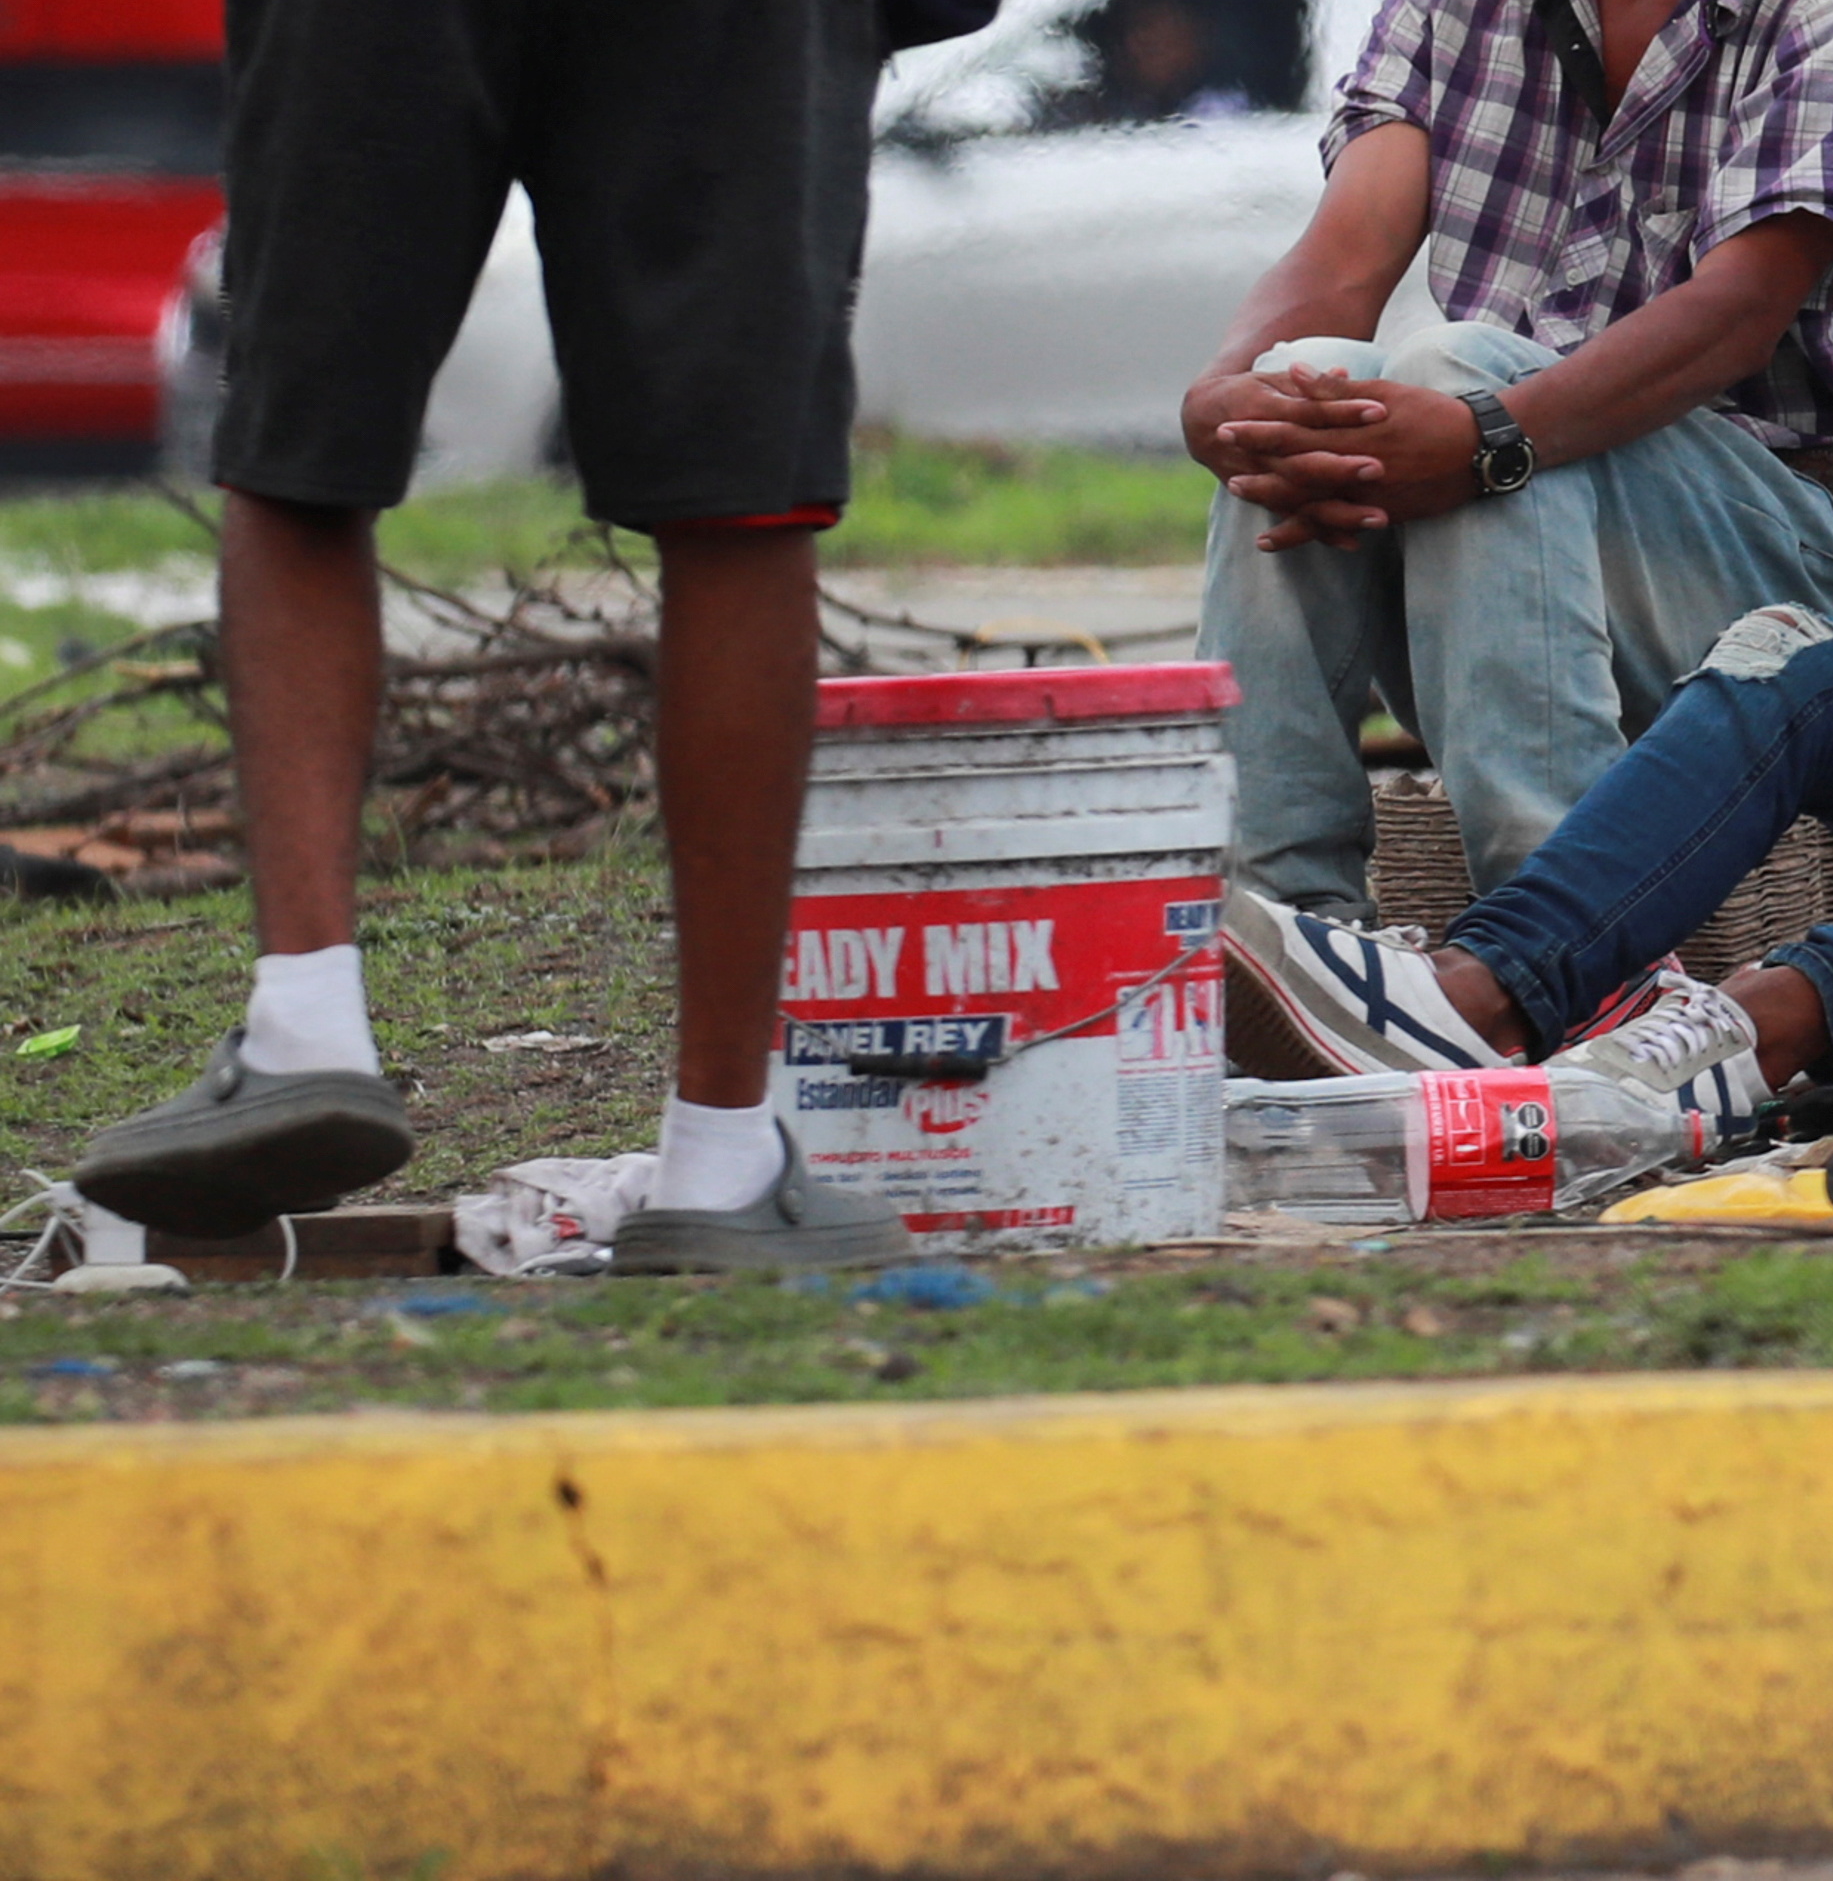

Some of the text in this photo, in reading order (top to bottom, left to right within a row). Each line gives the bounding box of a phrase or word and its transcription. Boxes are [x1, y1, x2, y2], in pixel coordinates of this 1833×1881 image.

[923, 920, 1060, 996] MIX
[791, 1021, 991, 1057] PANEL REY
